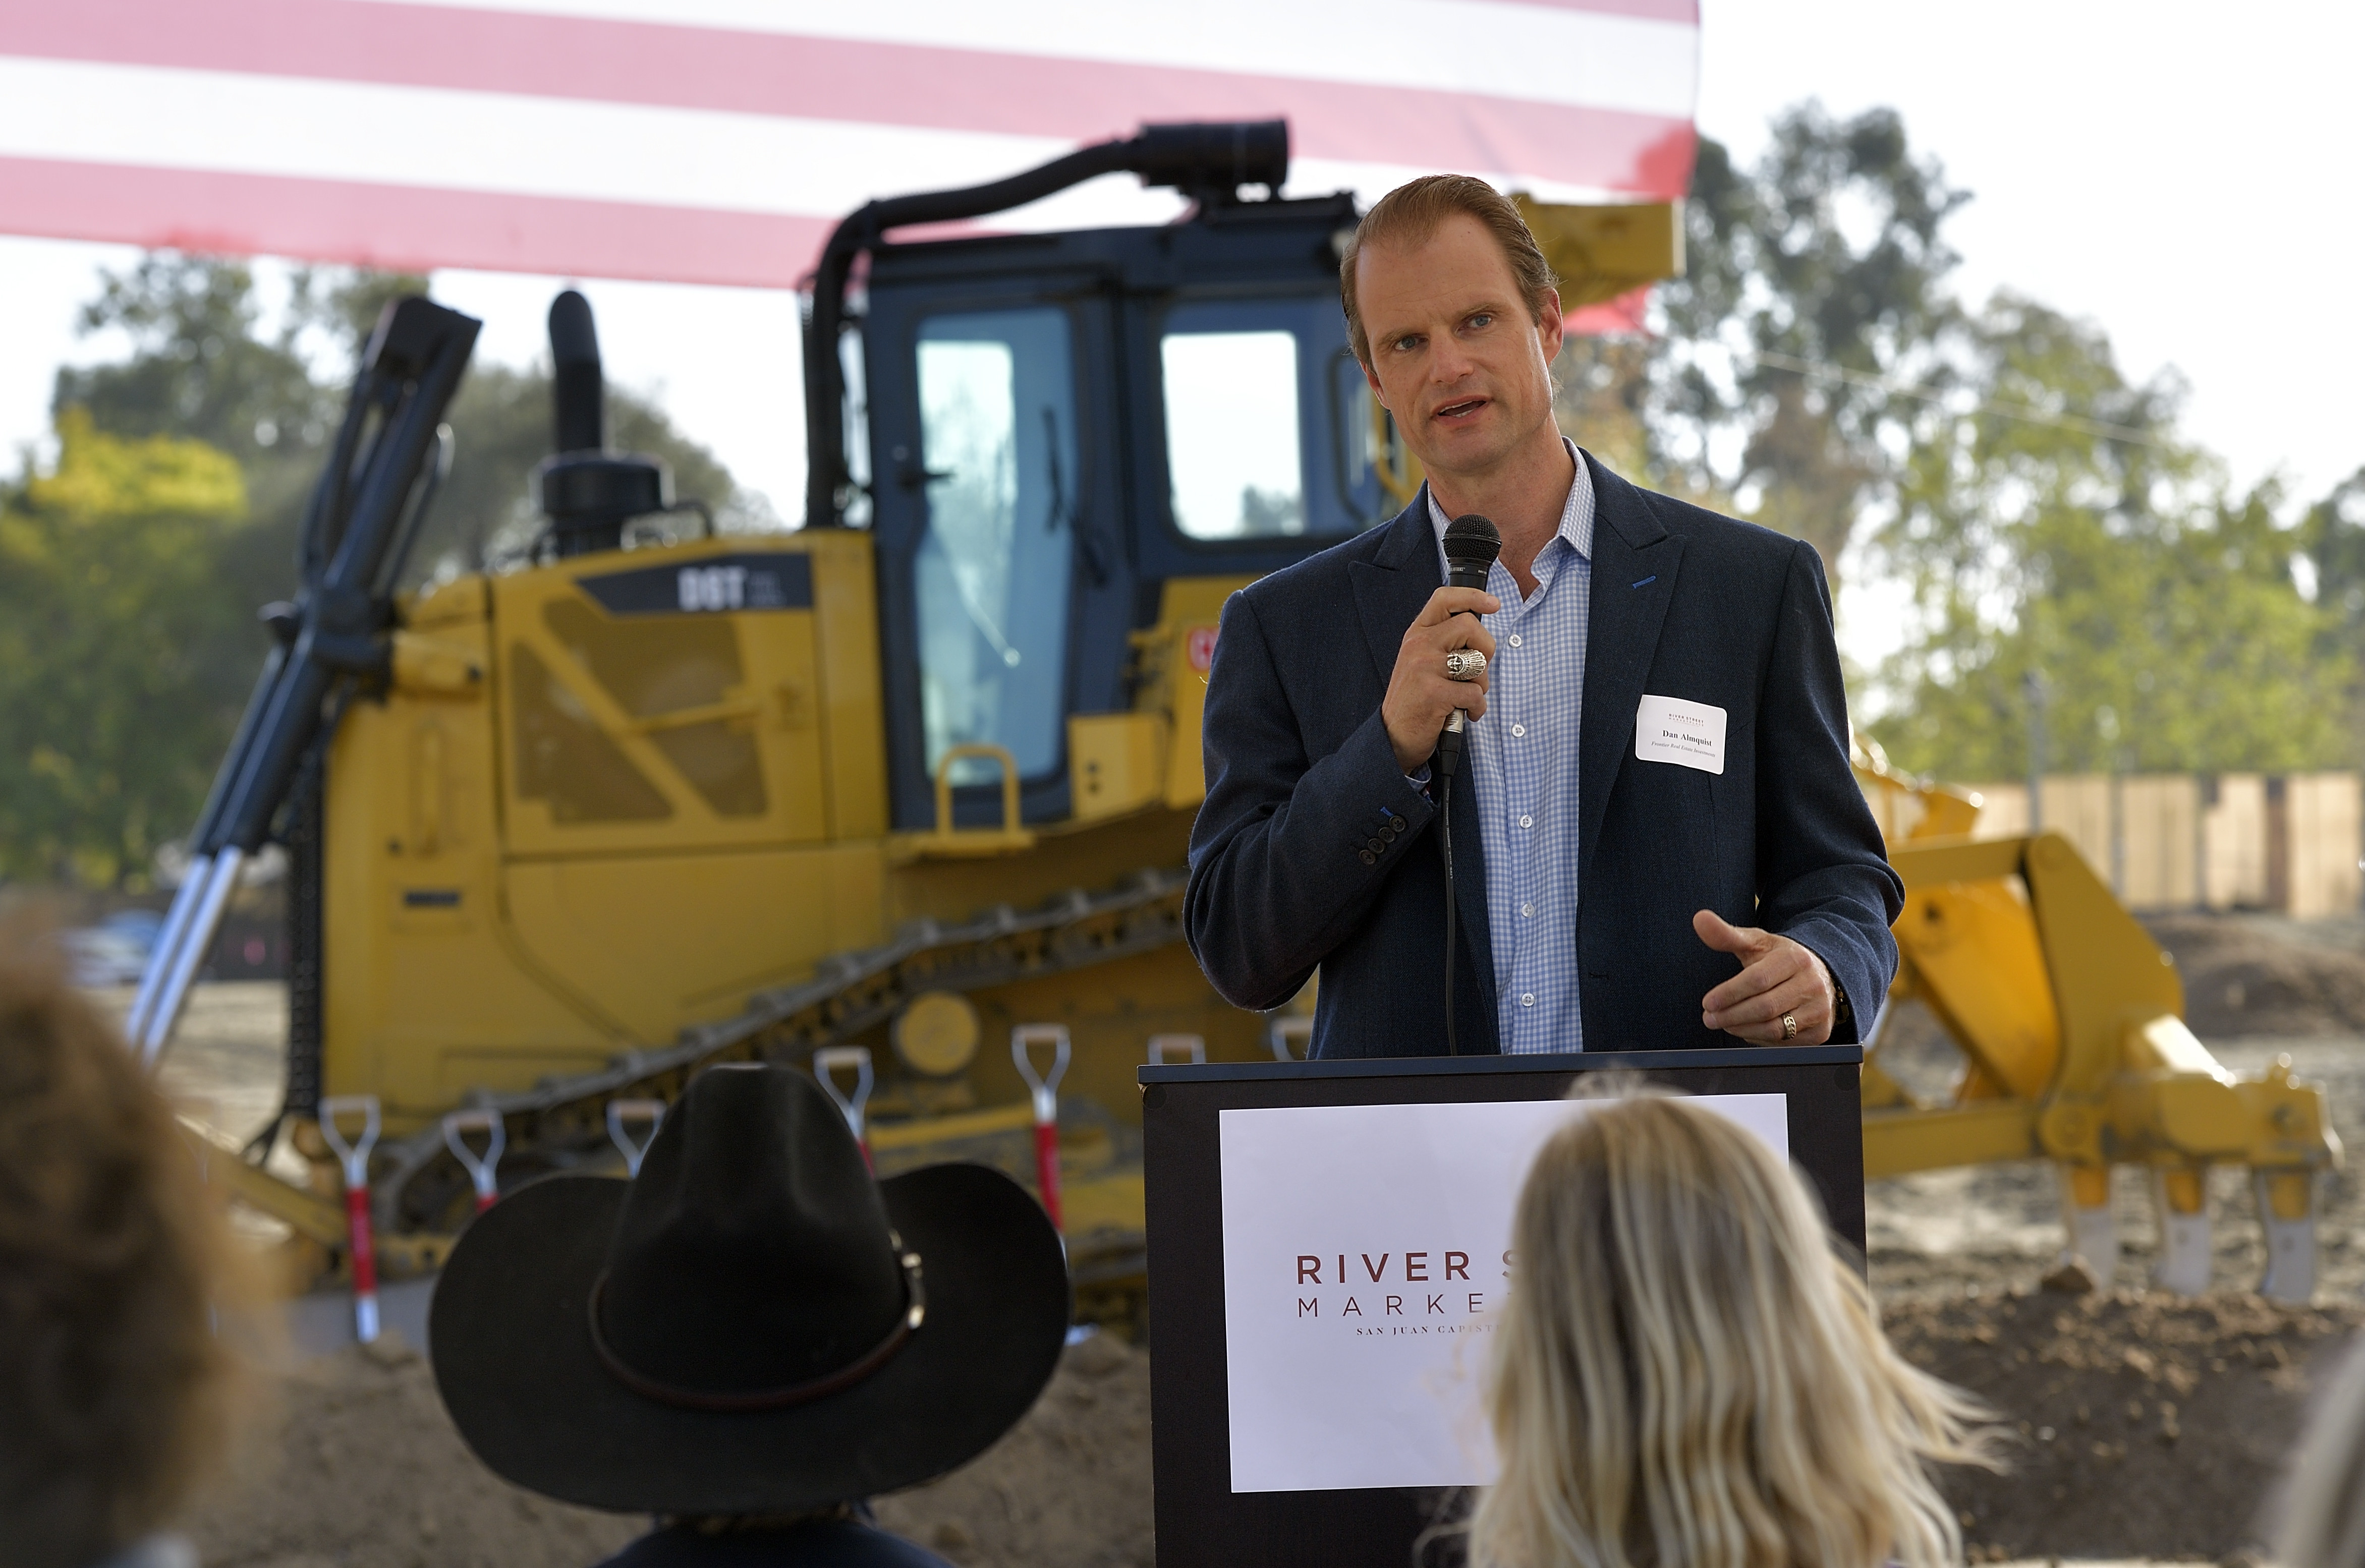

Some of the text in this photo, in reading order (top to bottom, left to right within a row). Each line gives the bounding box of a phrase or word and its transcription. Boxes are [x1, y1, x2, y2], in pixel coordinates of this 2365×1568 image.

[1663, 730, 1712, 746] Dan Almquist
[1693, 748, 1716, 758] Investments
[1297, 1251, 1471, 1285] RIVER
[1298, 1293, 1511, 1317] MARKE
[1356, 1327, 1384, 1336] SAN
[1392, 1325, 1429, 1335] JUAN
